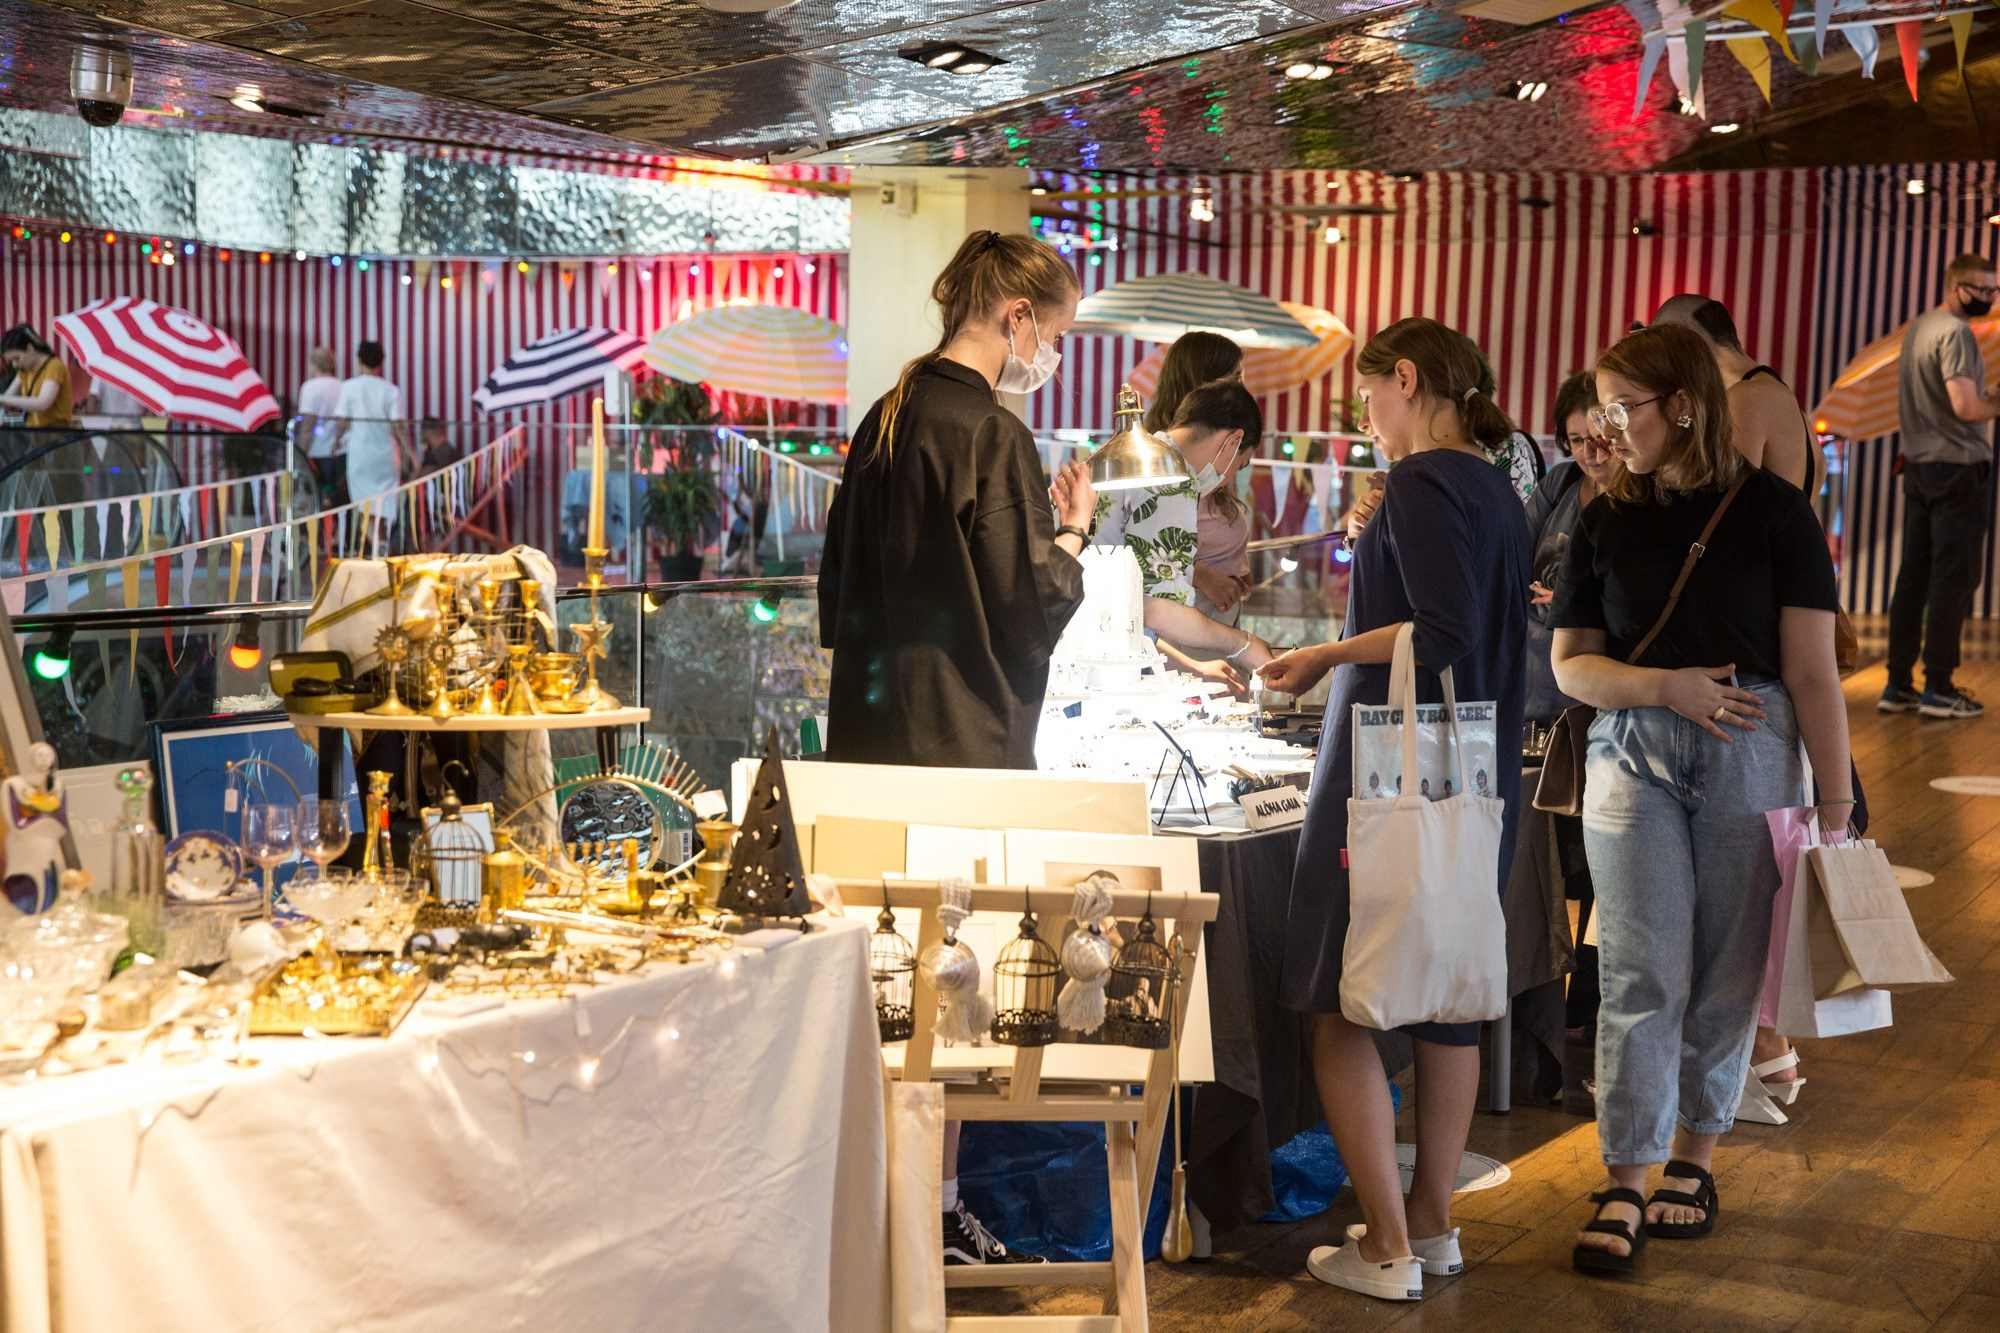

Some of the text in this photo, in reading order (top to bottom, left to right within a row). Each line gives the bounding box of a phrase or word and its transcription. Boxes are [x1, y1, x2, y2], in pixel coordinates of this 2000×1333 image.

[1360, 710, 1390, 726] BAY
[1390, 709, 1425, 725] CIY
[1280, 797, 1301, 812] GAIA
